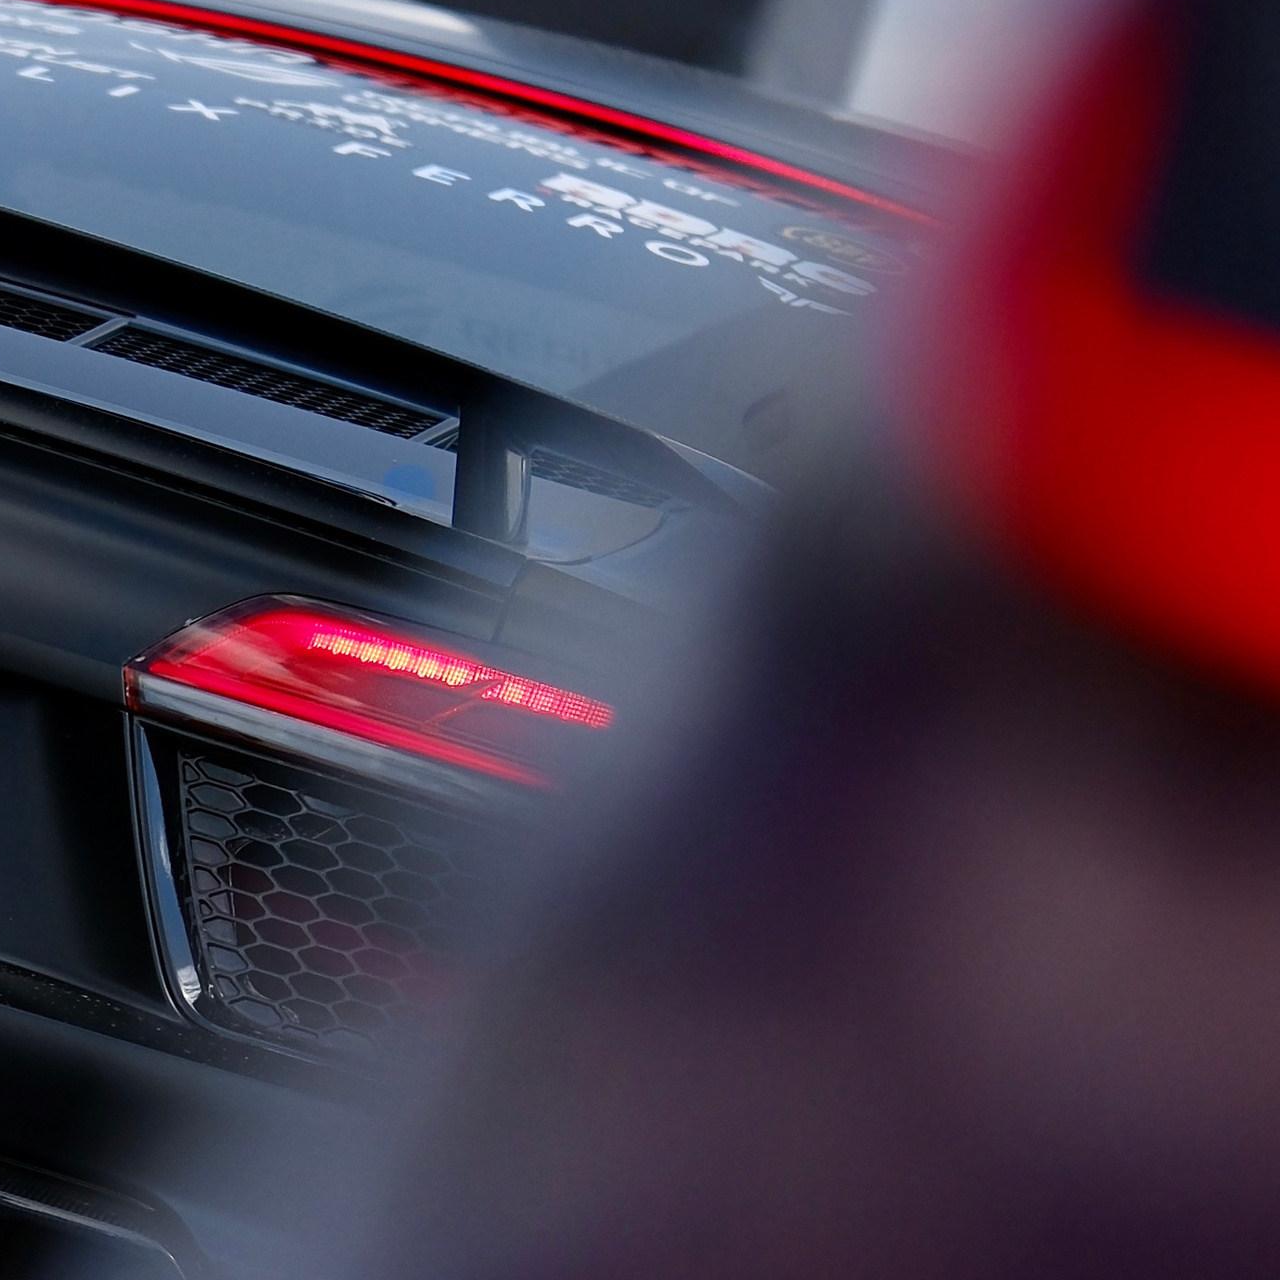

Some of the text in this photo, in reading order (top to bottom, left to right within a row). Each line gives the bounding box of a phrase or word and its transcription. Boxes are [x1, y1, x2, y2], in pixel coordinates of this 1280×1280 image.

[331, 141, 711, 268] FERRO
[540, 172, 878, 296] RDRC
[560, 193, 819, 288] RACEPARK
